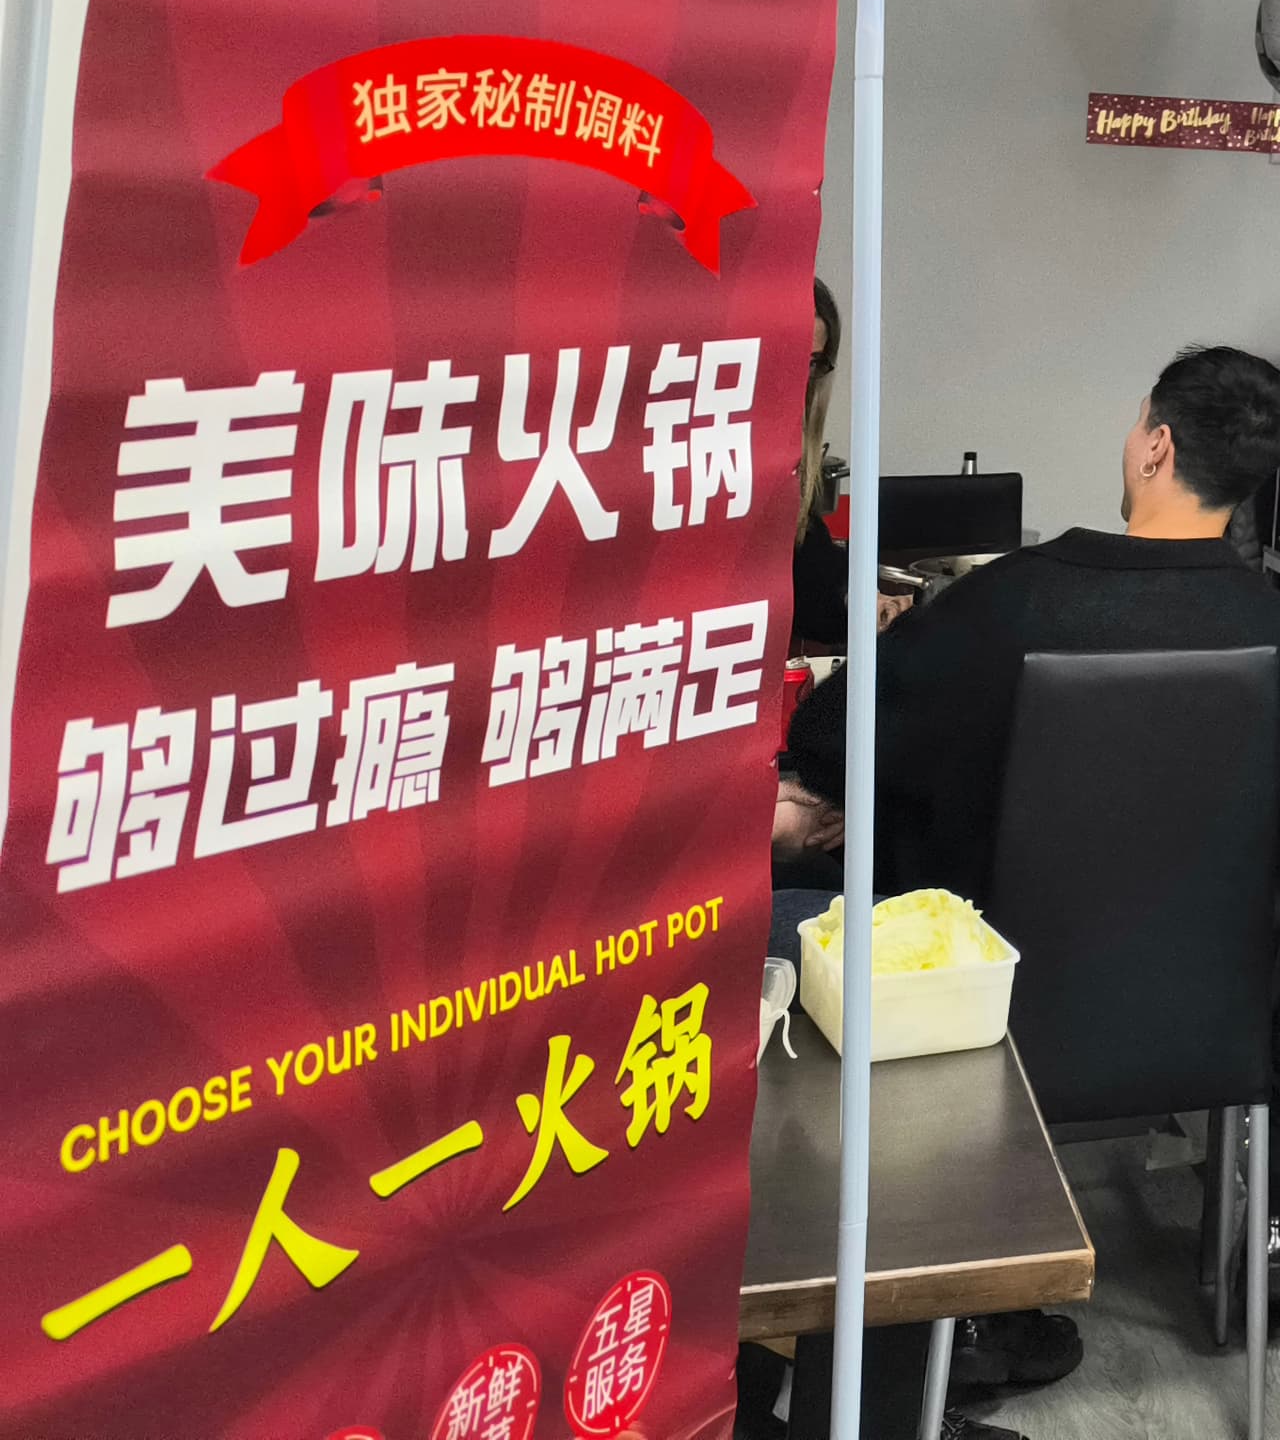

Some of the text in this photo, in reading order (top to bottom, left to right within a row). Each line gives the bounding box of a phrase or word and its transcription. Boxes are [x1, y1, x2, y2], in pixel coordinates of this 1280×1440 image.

[353, 67, 663, 168] 独家秘制调料
[1096, 106, 1231, 137] Happy Birthday
[108, 338, 762, 627] 美味火锅
[45, 600, 769, 893] 够过瘾 够满足
[60, 896, 724, 1172] CHOOSE YOUR INDIVIDUAL HOT POT
[41, 982, 713, 1340] 一人一火锅
[588, 1284, 655, 1361] 五星
[446, 1354, 524, 1439] 新鲜
[582, 1343, 648, 1422] 服务
